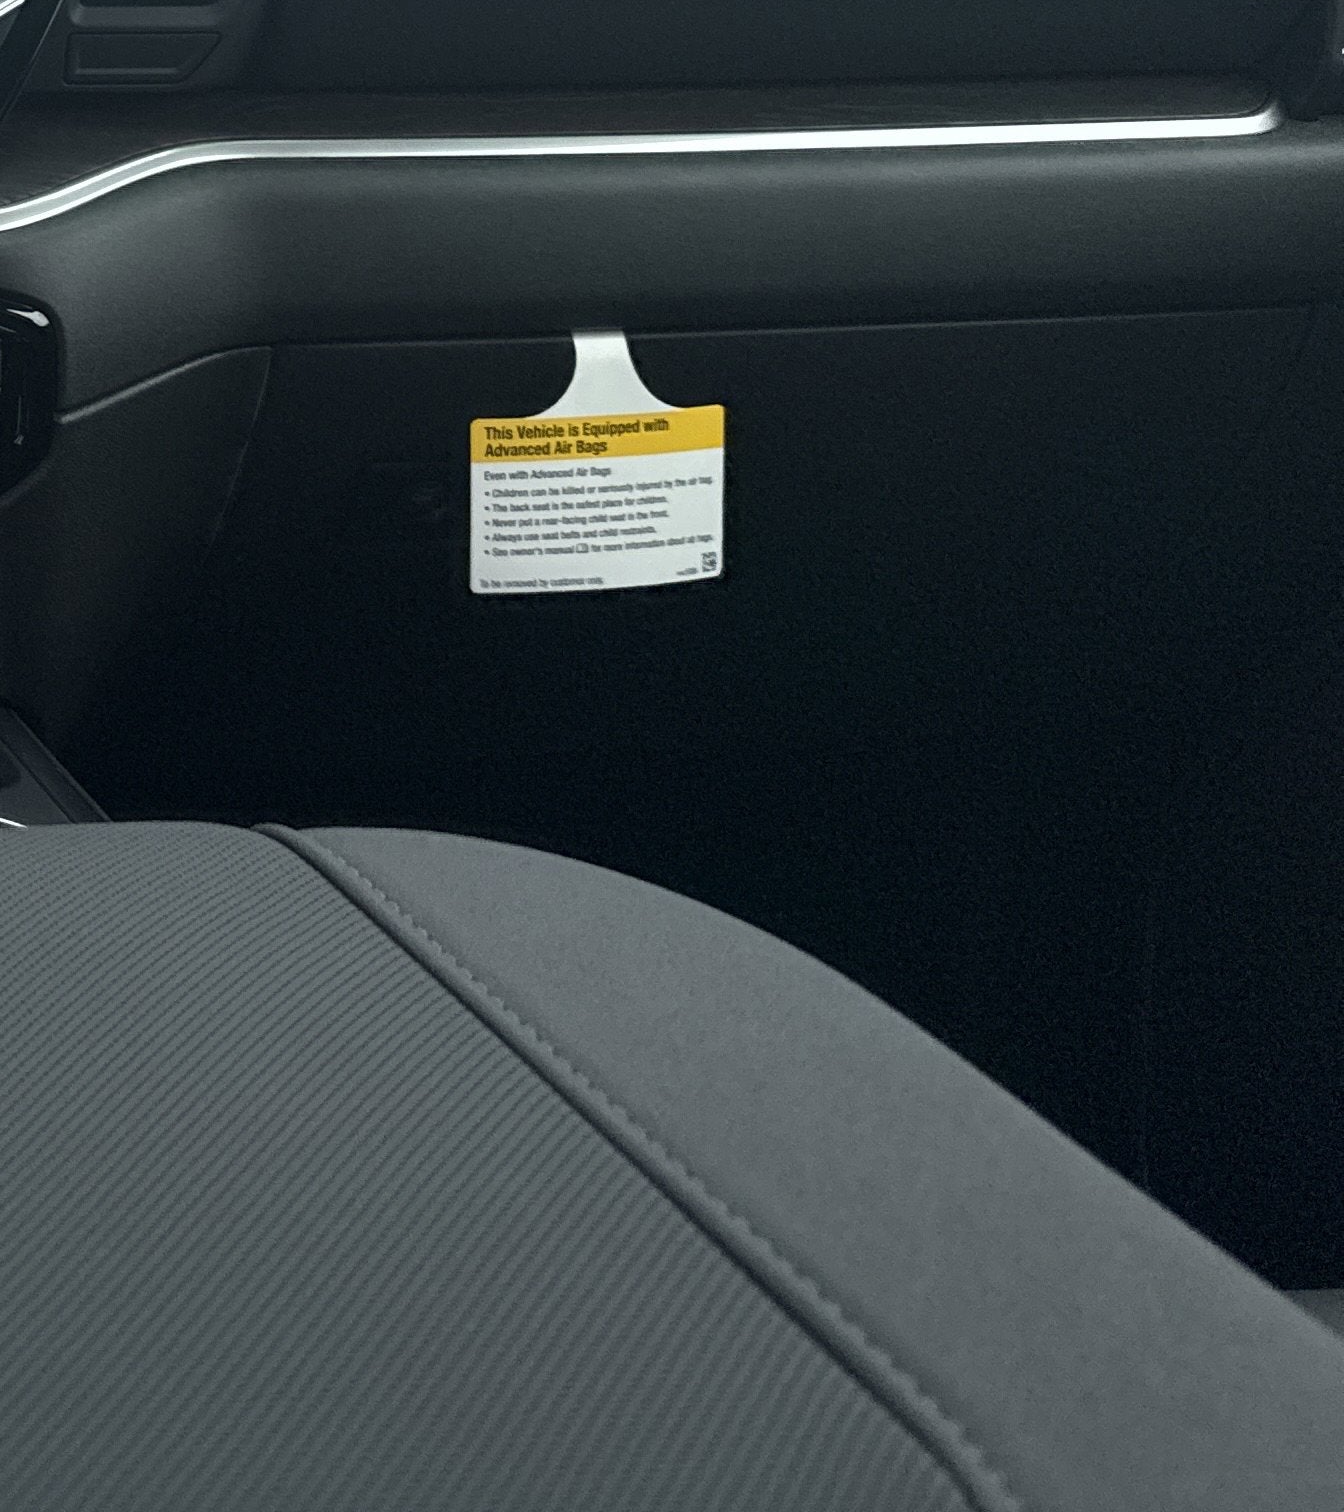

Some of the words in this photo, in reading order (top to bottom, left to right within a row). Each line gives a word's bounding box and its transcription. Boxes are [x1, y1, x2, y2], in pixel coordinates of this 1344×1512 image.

[484, 426, 513, 440] This
[516, 424, 564, 439] Vehicle
[568, 423, 579, 437] is
[582, 420, 640, 438] Equipped
[643, 418, 669, 432] with
[484, 442, 551, 457] Advanced
[554, 441, 572, 455] Air
[576, 440, 608, 456] Bags
[484, 471, 506, 481] Even
[509, 470, 529, 480] with
[531, 469, 573, 479] Advanced
[576, 467, 588, 477] Air
[590, 467, 611, 477] Bags
